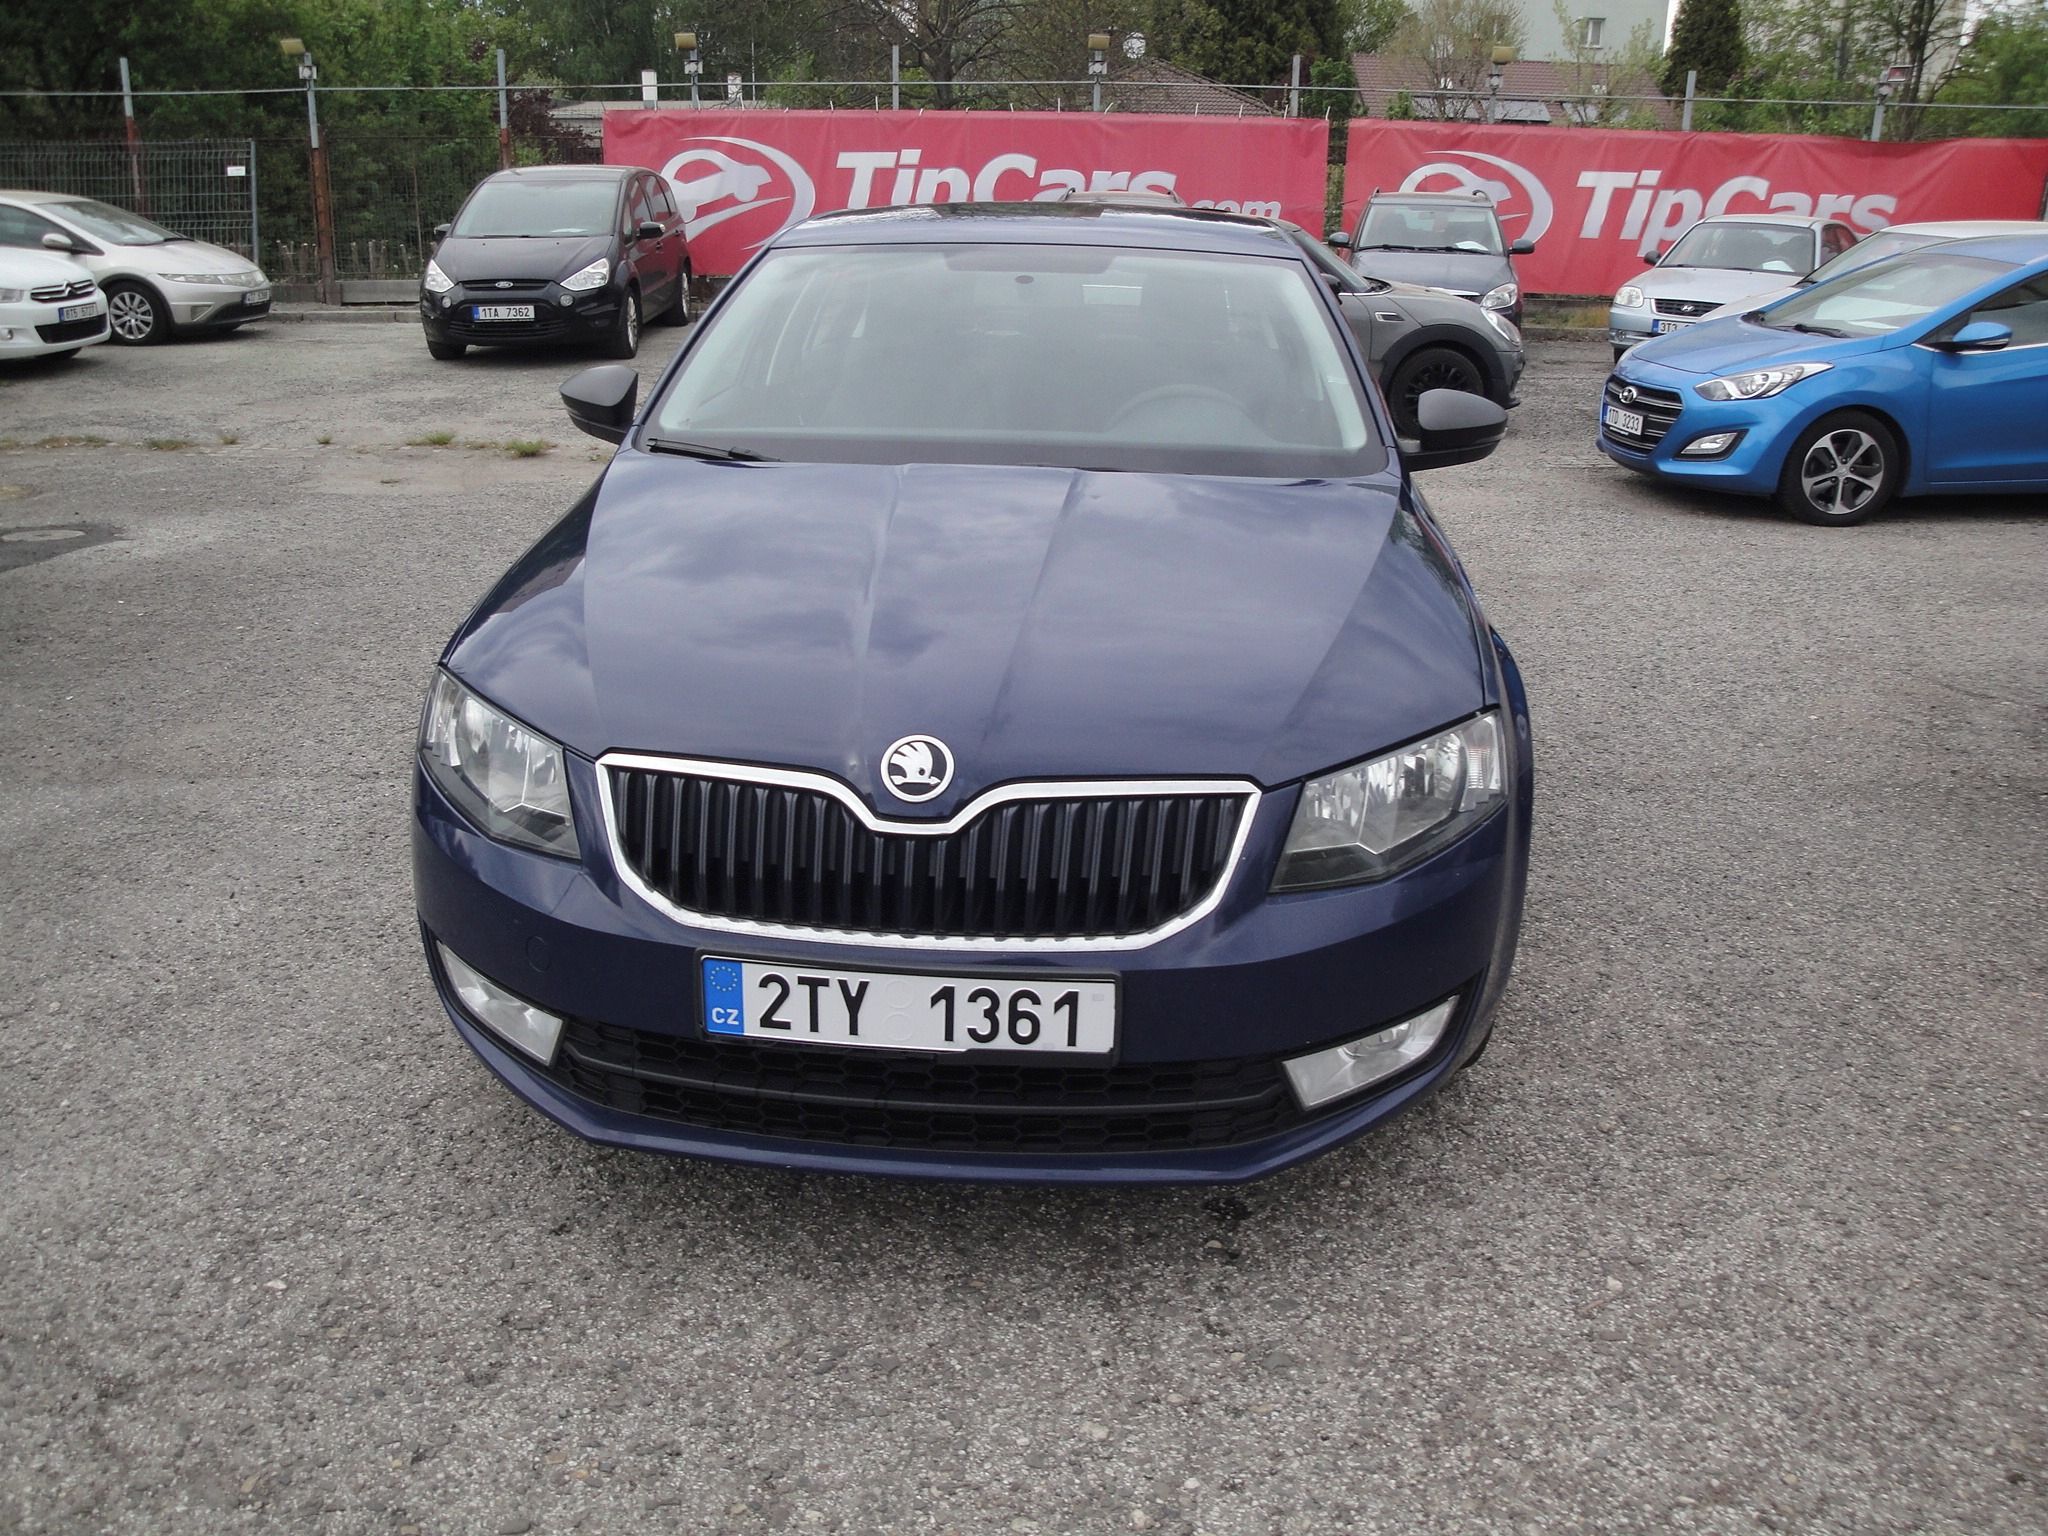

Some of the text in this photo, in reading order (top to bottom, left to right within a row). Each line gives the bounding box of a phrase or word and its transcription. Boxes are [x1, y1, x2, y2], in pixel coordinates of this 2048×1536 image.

[482, 307, 499, 318] 1TA
[506, 307, 530, 317] 7362
[712, 1007, 739, 1025] CZ
[758, 972, 1080, 1047] 2TY 1361
